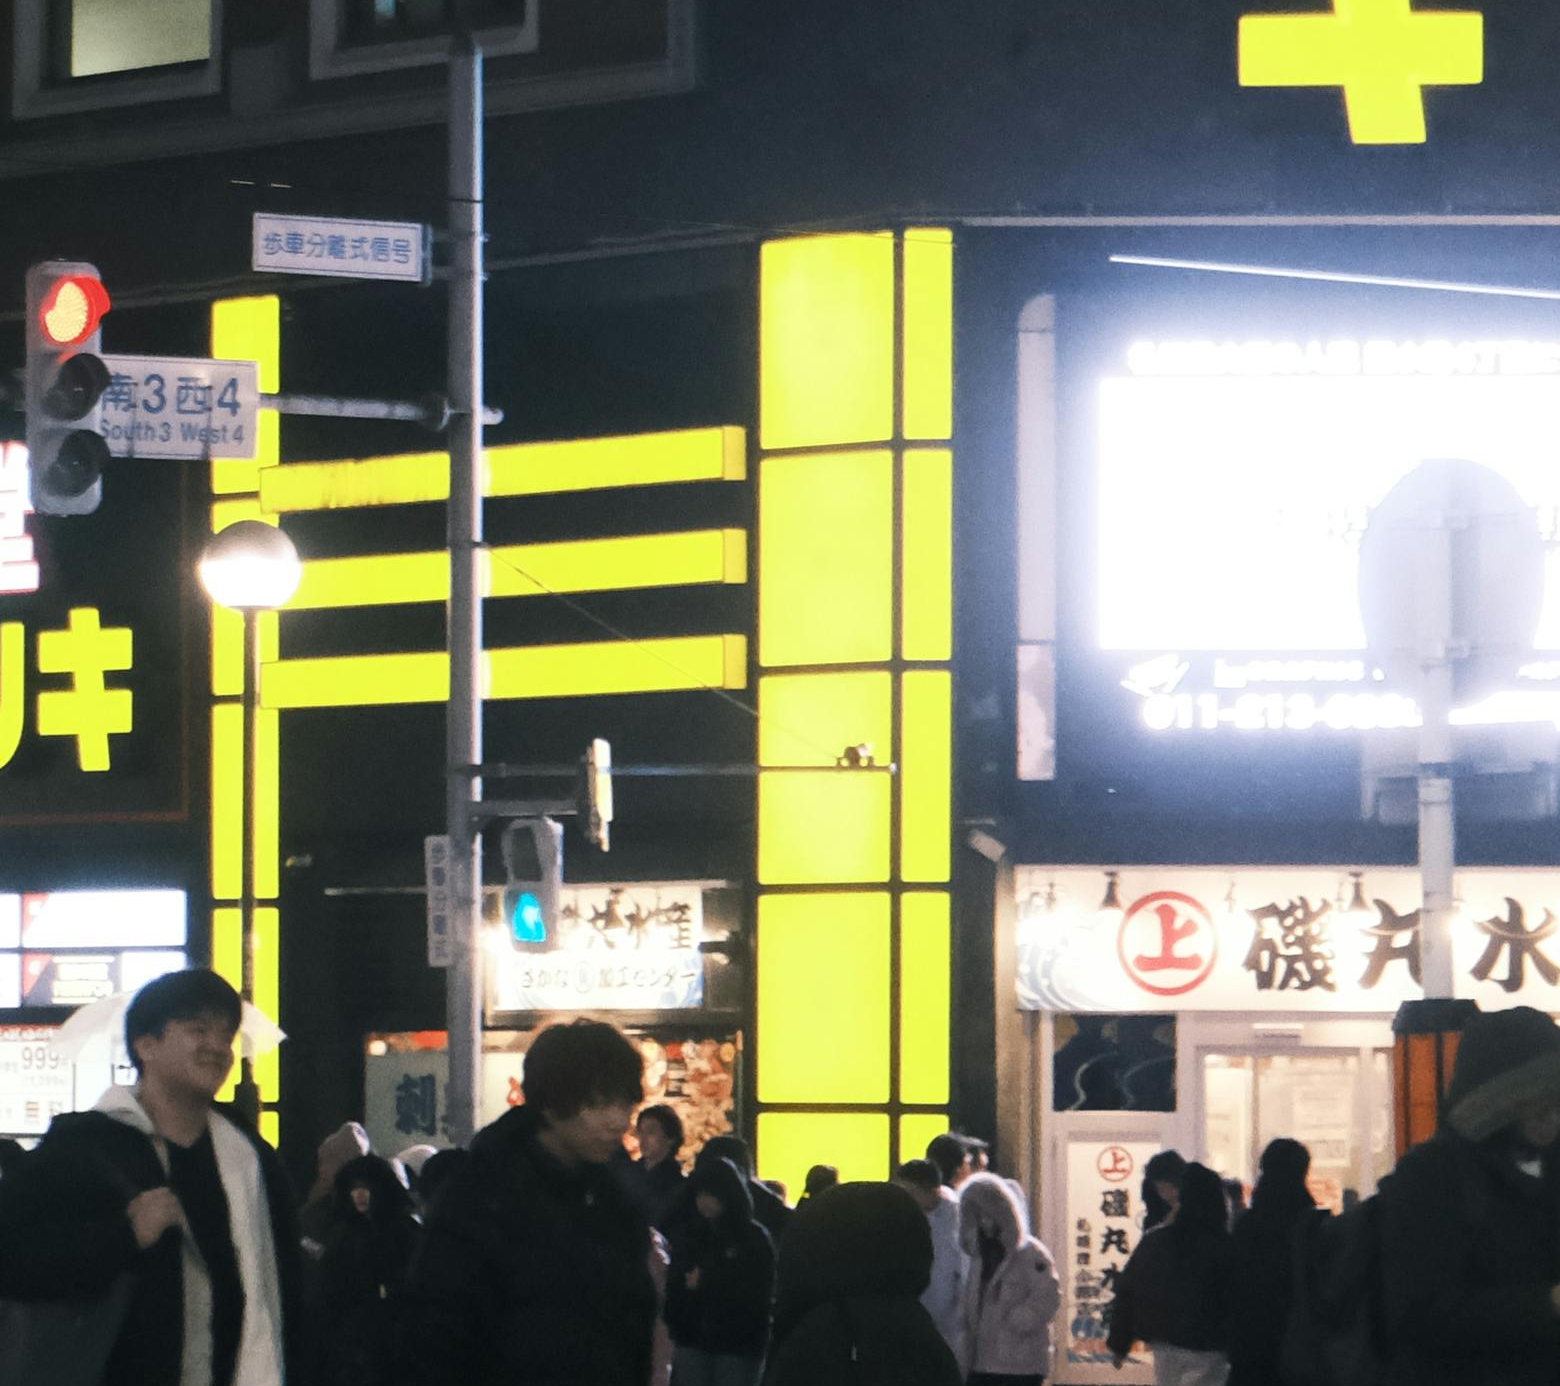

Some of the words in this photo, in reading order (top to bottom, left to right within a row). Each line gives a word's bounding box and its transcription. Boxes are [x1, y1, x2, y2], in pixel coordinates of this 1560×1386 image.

[263, 231, 411, 265] 歩車分離式信号
